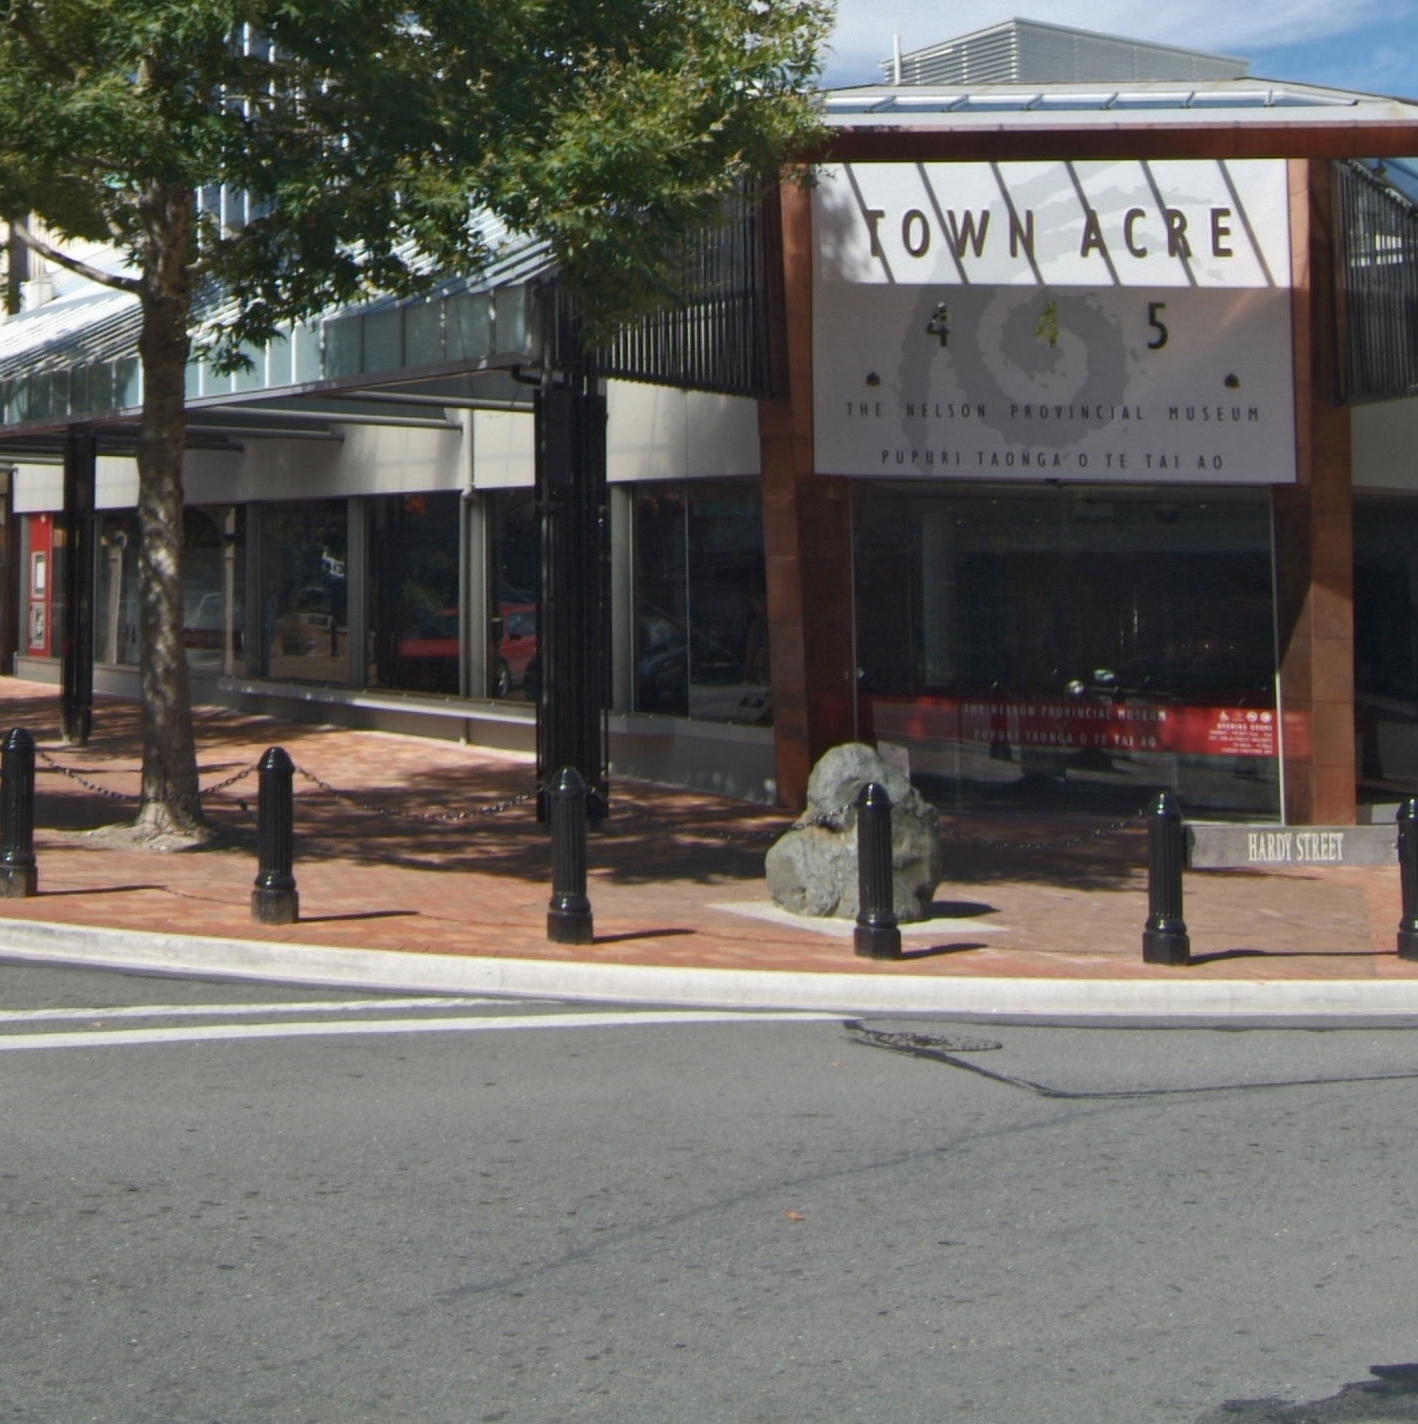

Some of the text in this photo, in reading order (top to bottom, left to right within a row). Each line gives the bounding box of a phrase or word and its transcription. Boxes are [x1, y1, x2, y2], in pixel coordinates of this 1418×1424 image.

[863, 208, 1234, 259] TOWN ACRE
[847, 402, 1259, 422] THE NELSON PROVINCIAL MUSEUM
[882, 449, 1224, 470] PUPURI TAONGA O TE TAI AO
[1041, 706, 1112, 719] PROVINCIAL
[1118, 709, 1167, 722] MUSEUM
[1248, 832, 1344, 862] HARDY STREET
